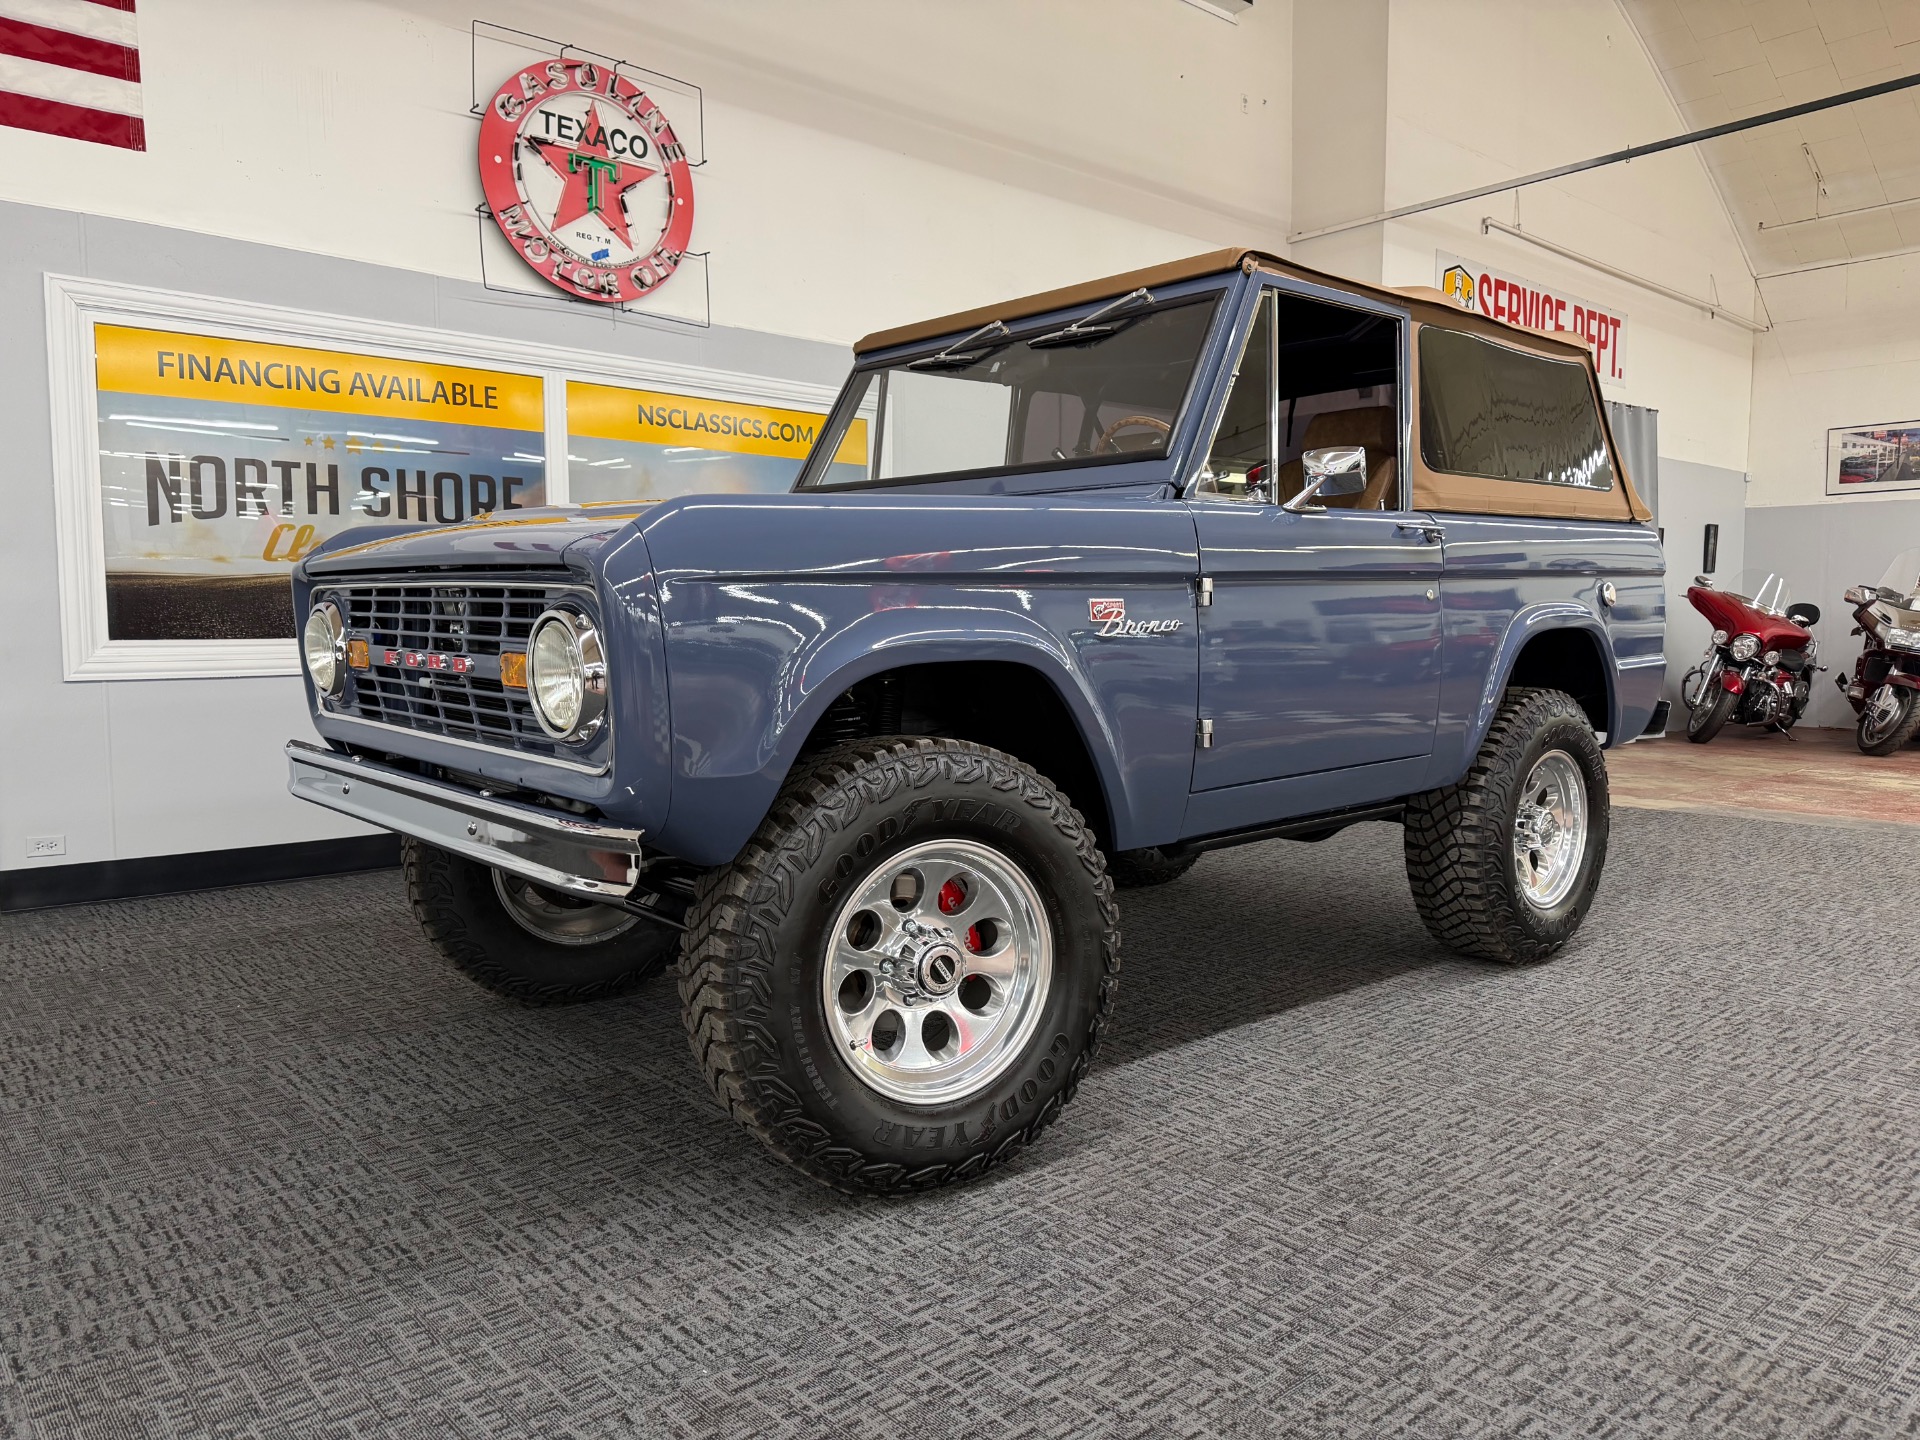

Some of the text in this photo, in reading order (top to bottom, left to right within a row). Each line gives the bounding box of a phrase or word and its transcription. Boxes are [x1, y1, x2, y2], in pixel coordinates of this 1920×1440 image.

[495, 62, 686, 162] GASOLINE
[539, 109, 648, 159] TEXACO
[499, 203, 623, 299] MOTOR
[157, 351, 499, 410] FINANCING AVAILABLE
[637, 404, 814, 445] NSCLASSICS.COM
[145, 451, 340, 527] NORTH
[1094, 608, 1184, 637] Bronco
[383, 649, 475, 674] FORD
[790, 1003, 839, 1111] TERRITORY
